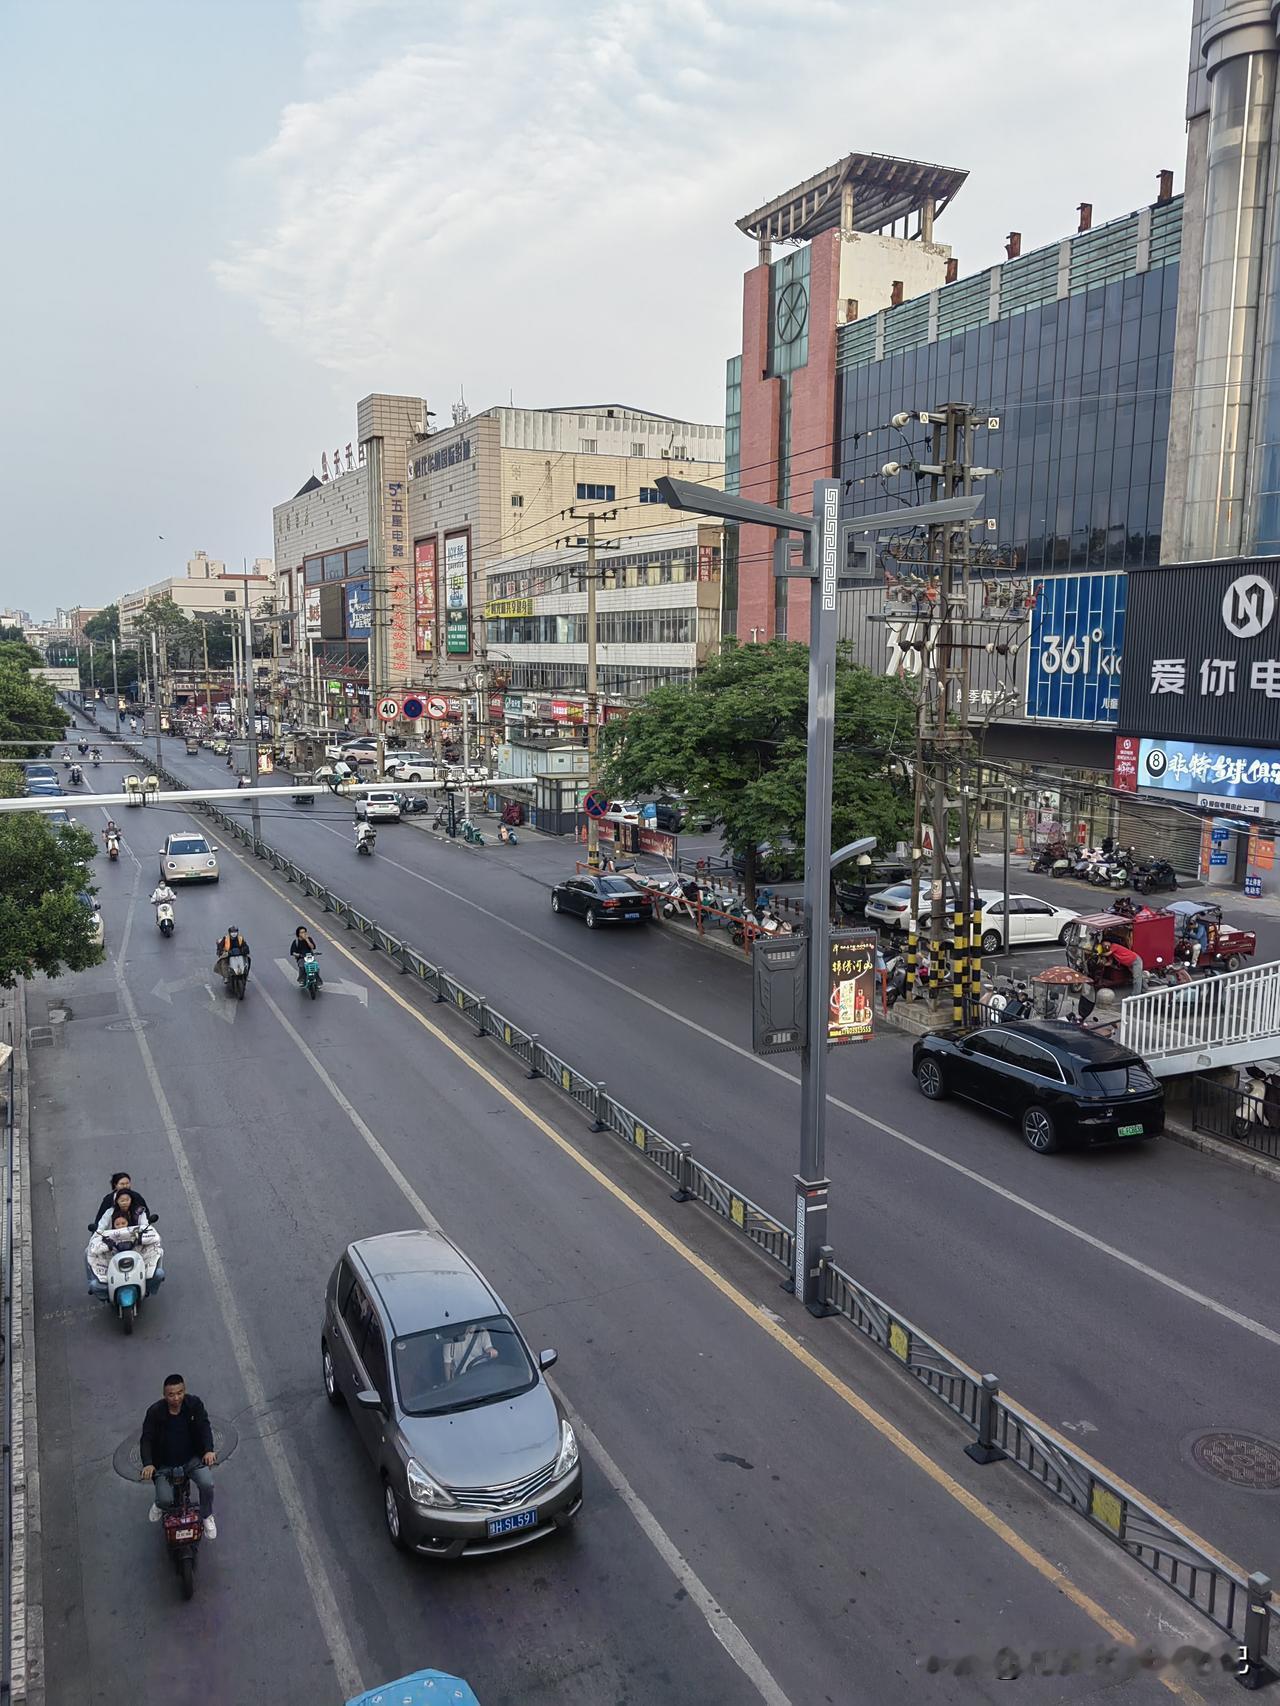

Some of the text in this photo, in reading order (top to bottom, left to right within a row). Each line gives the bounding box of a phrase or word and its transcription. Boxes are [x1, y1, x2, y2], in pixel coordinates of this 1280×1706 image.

[391, 499, 404, 557] 五星电器
[1042, 628, 1103, 674] 361°
[1150, 658, 1280, 698] 爱你电
[382, 703, 395, 715] 40
[1153, 754, 1160, 767] 8
